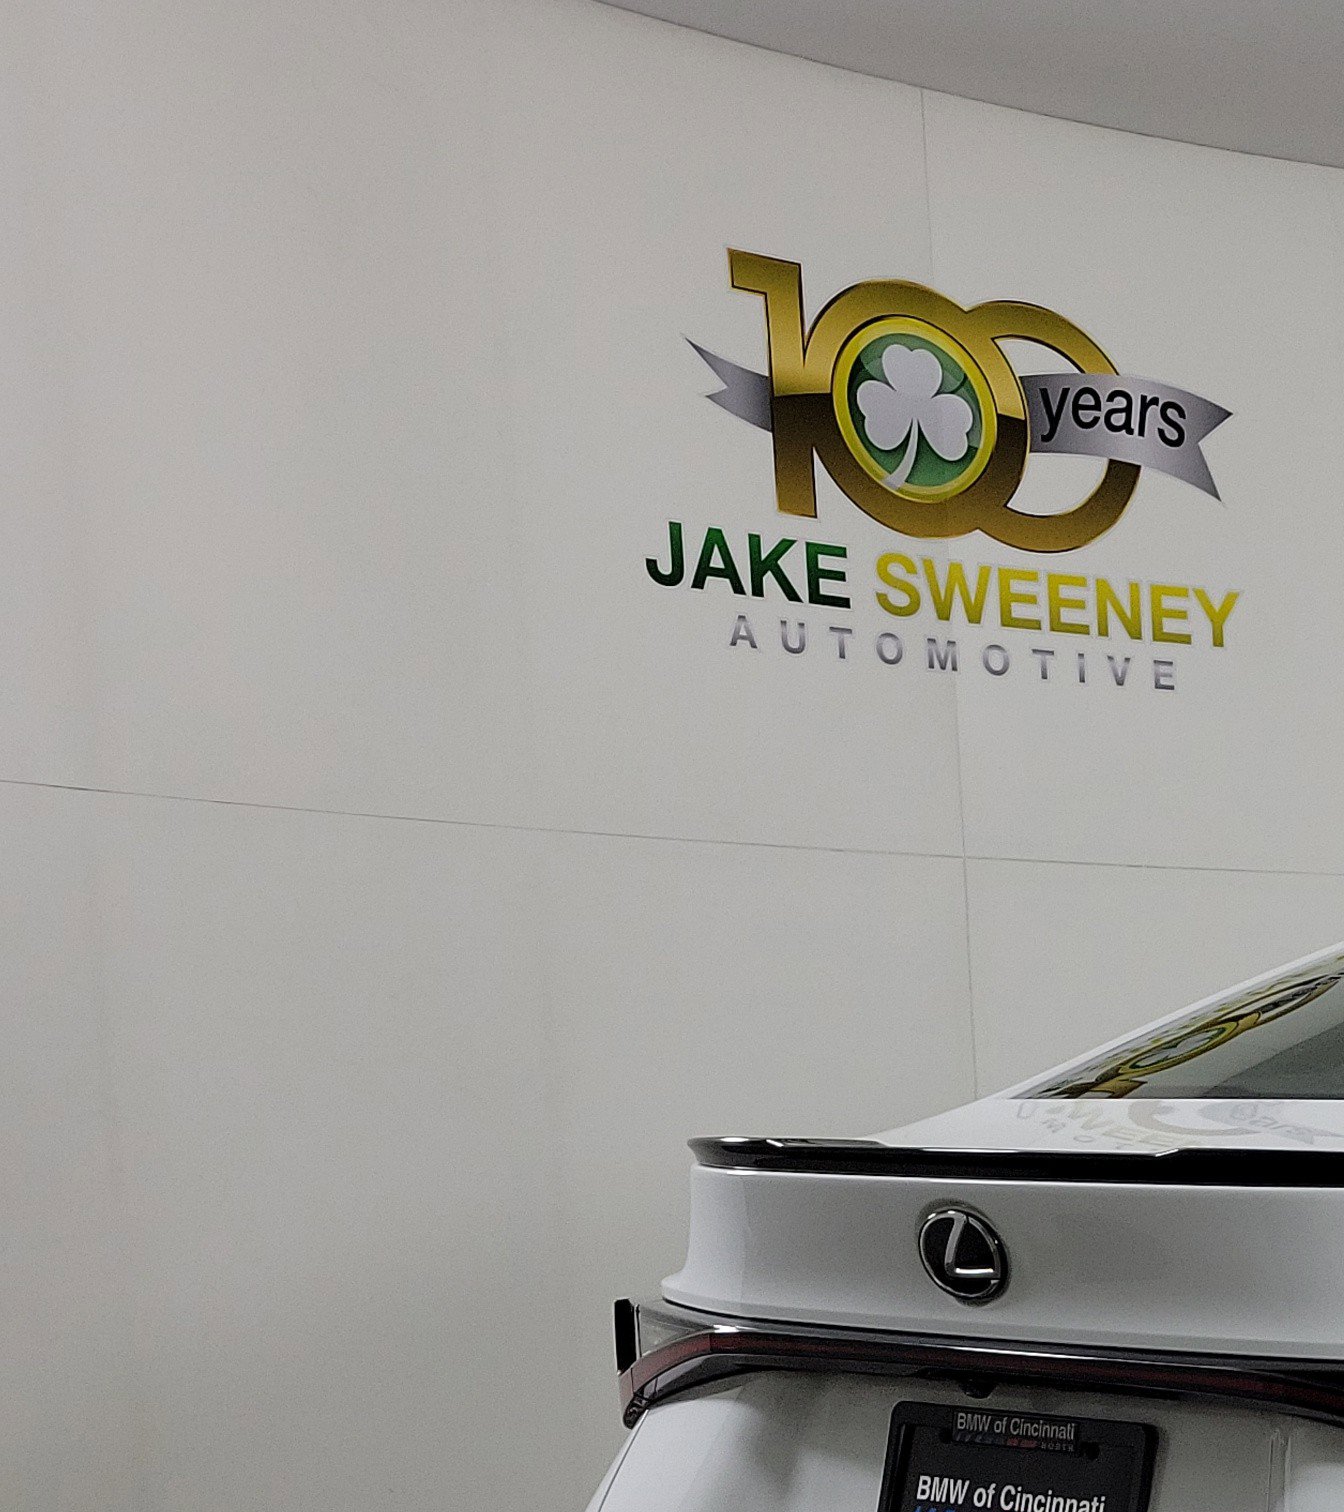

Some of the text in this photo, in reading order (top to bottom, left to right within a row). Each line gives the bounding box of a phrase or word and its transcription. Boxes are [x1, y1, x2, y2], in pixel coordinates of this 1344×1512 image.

[726, 246, 1188, 554] 100 years
[644, 521, 1241, 648] JAKE SWEENEY
[729, 614, 1176, 691] AUTOMOTIVE
[956, 1412, 1075, 1440] BMW of Cincinnati
[916, 1475, 970, 1505] BMW
[973, 1483, 996, 1508] of
